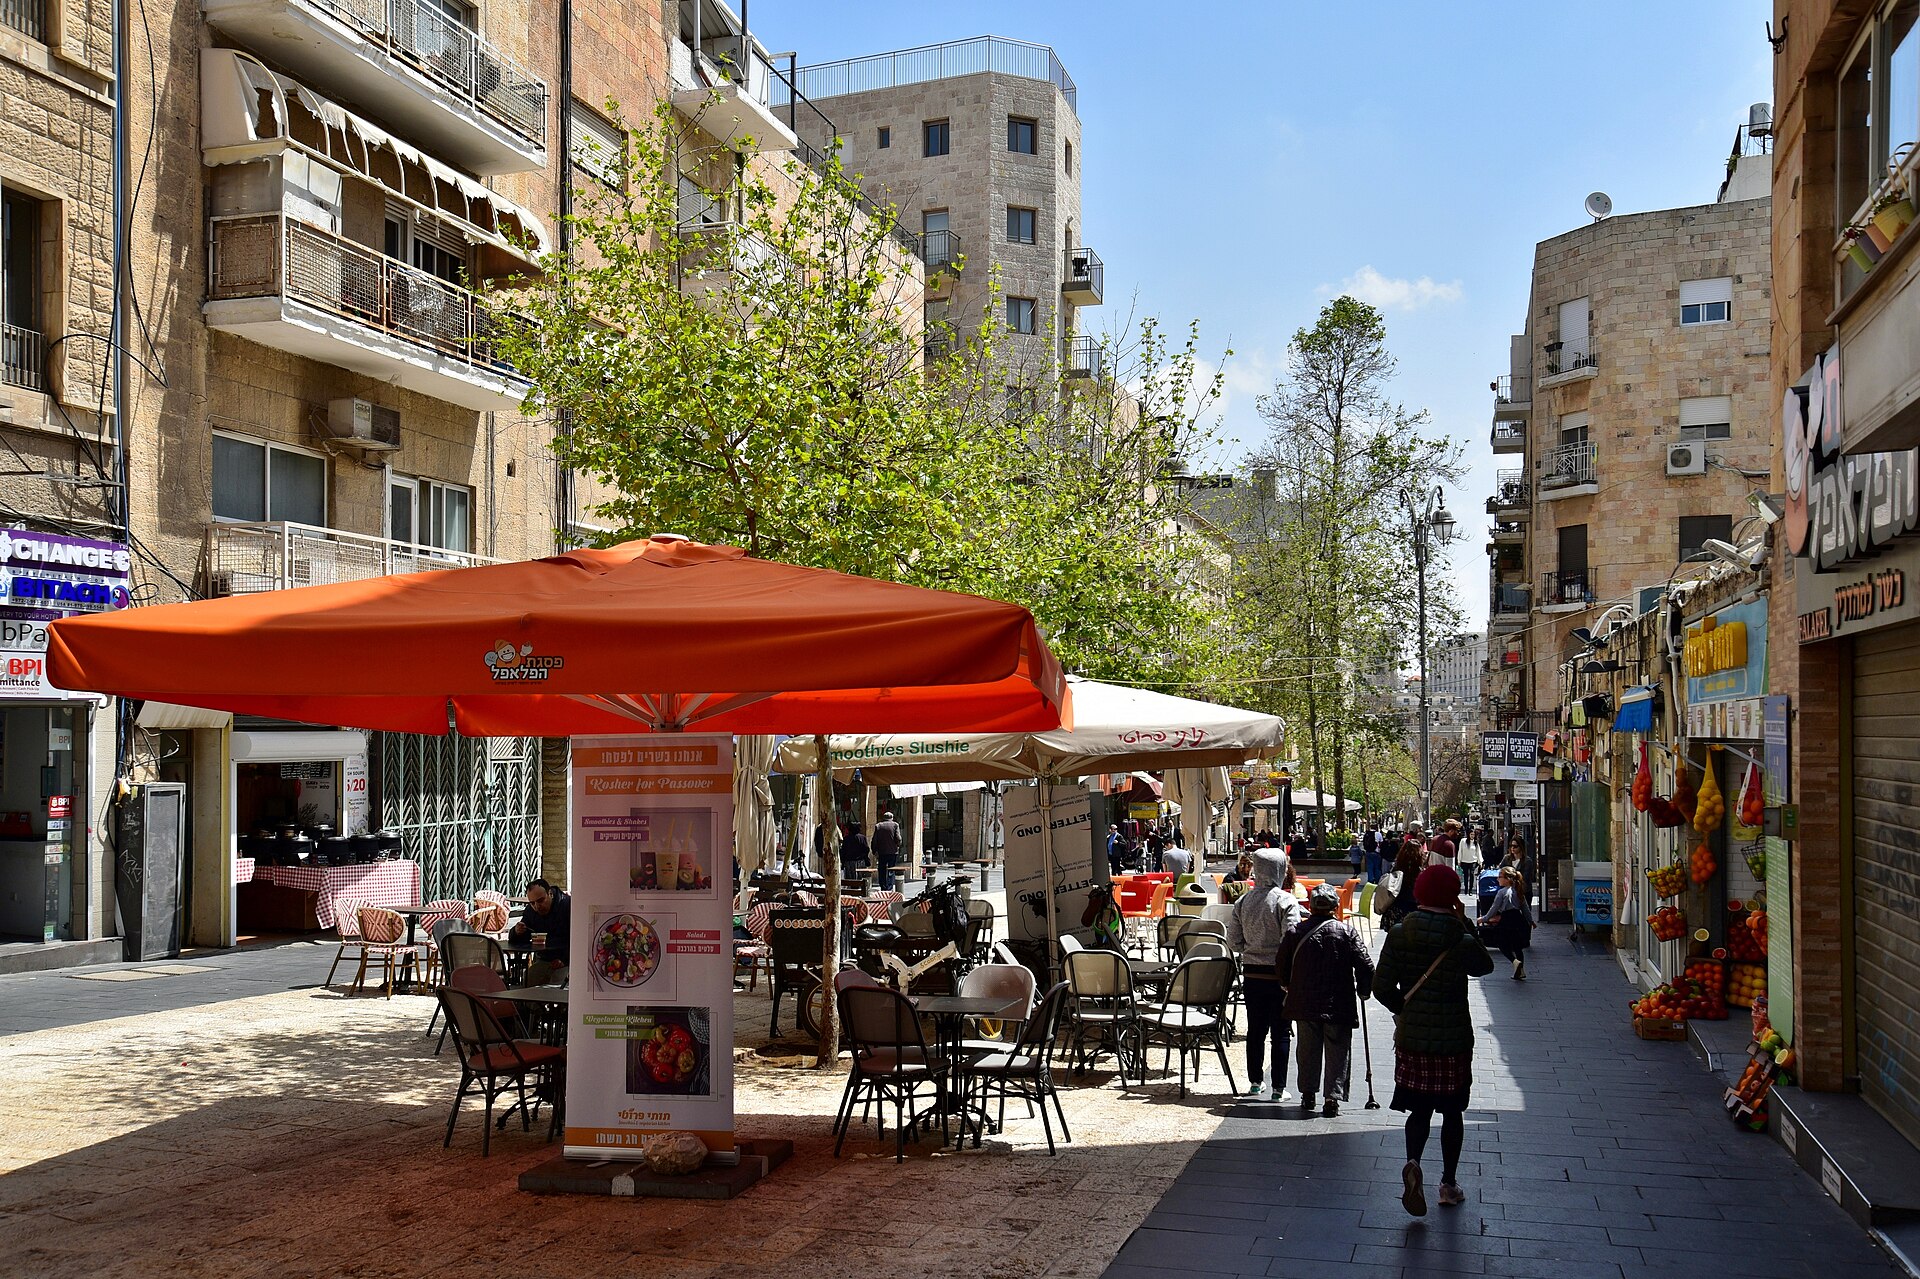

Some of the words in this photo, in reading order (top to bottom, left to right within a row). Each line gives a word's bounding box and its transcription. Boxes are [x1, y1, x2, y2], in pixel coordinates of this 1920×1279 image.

[14, 539, 113, 569] CHANGE
[13, 577, 111, 604] BITACH
[1798, 608, 1832, 643] FALAFEL
[8, 658, 42, 676] BPI
[525, 657, 564, 668] פסגת
[491, 664, 548, 680] הפלאפל
[909, 739, 970, 754] Slushie
[1509, 737, 1535, 746] המרצים
[601, 749, 634, 764] לפסח!
[637, 751, 671, 763] כשרים
[673, 750, 703, 763] אנחנו
[1486, 750, 1503, 758] ביותר
[590, 778, 634, 792] Kosher
[636, 778, 655, 792] for
[657, 777, 714, 790] Passover
[58, 797, 70, 806] BPI
[584, 817, 616, 825] Smoothies
[616, 818, 622, 826] &
[1016, 812, 1092, 838] GETTEROND
[585, 1015, 625, 1024] Vegetarian
[625, 1015, 652, 1024] Kitchen
[617, 1109, 645, 1120] פרוטי
[646, 1111, 671, 1121] תותי
[625, 1133, 638, 1145] חג
